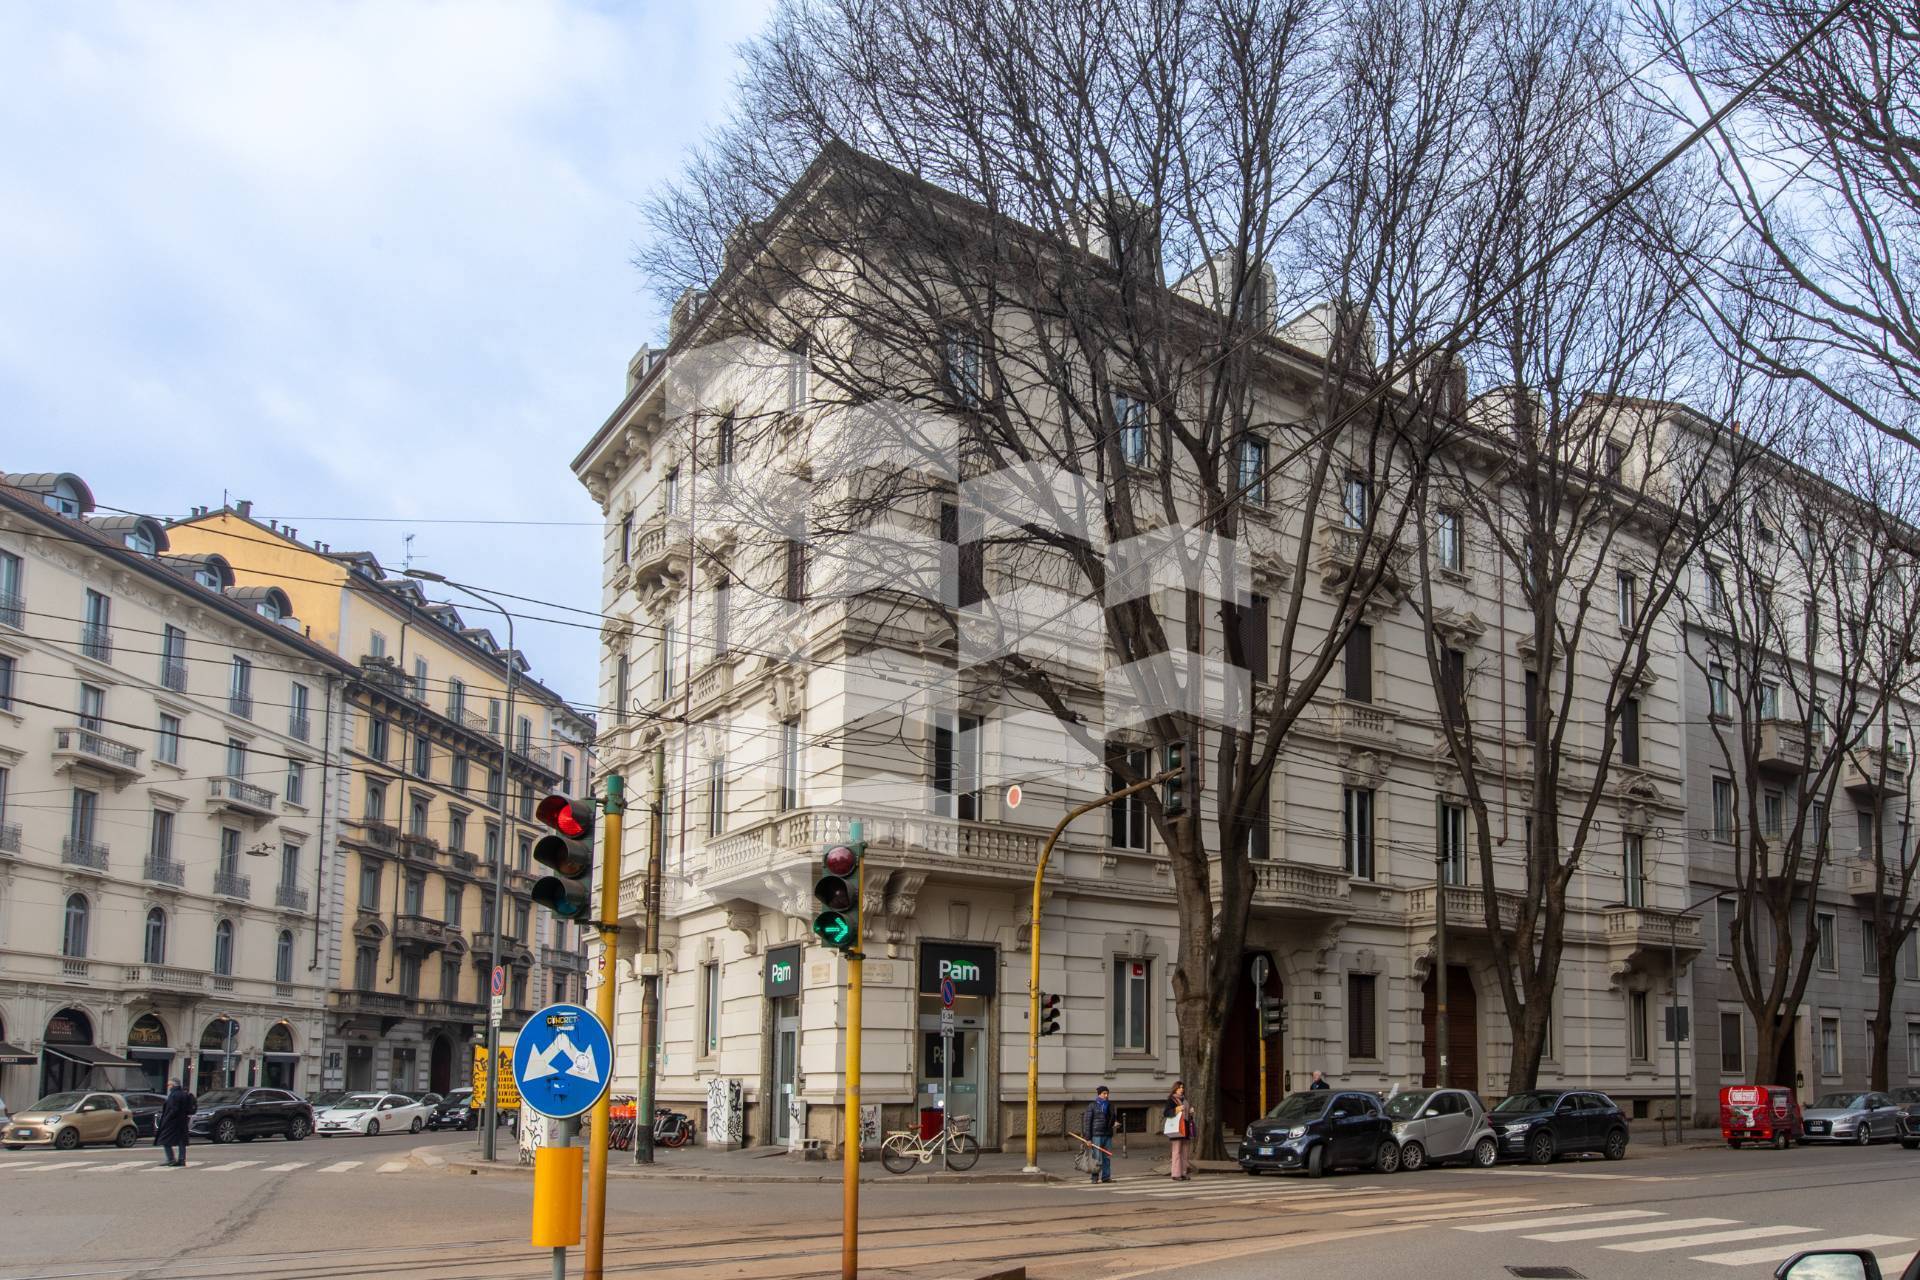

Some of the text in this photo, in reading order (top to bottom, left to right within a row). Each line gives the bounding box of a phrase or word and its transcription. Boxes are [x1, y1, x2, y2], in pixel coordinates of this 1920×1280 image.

[772, 963, 791, 982] Pam
[939, 960, 980, 981] Pam
[933, 1046, 956, 1064] Pa
